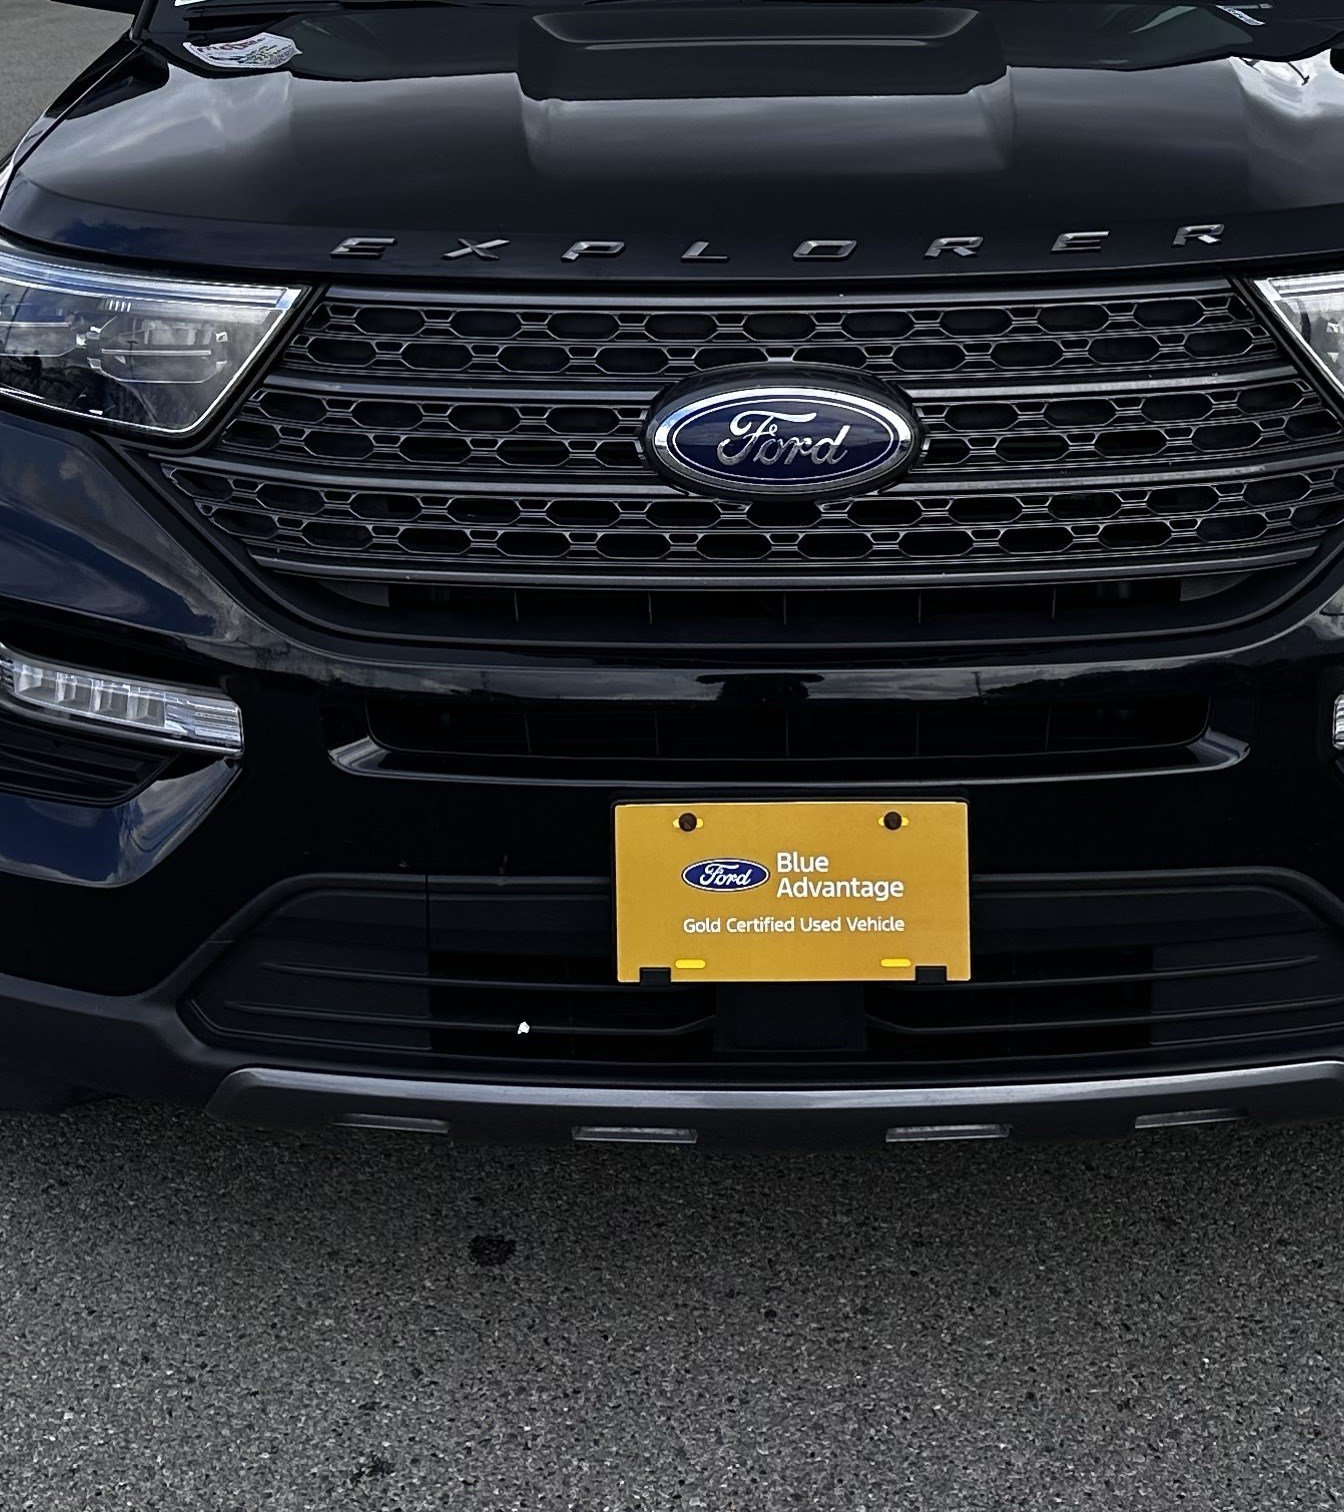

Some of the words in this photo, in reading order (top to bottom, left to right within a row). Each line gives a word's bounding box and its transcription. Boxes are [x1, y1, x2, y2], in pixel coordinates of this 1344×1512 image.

[329, 223, 1226, 263] EXPLORER
[715, 410, 851, 466] Ford
[776, 851, 829, 874] Blue
[699, 863, 752, 887] Ford
[776, 877, 905, 902] Advantage
[683, 917, 721, 934] Gold
[726, 915, 795, 934] Certified
[800, 916, 842, 933] Used
[846, 915, 905, 933] Vehicle
